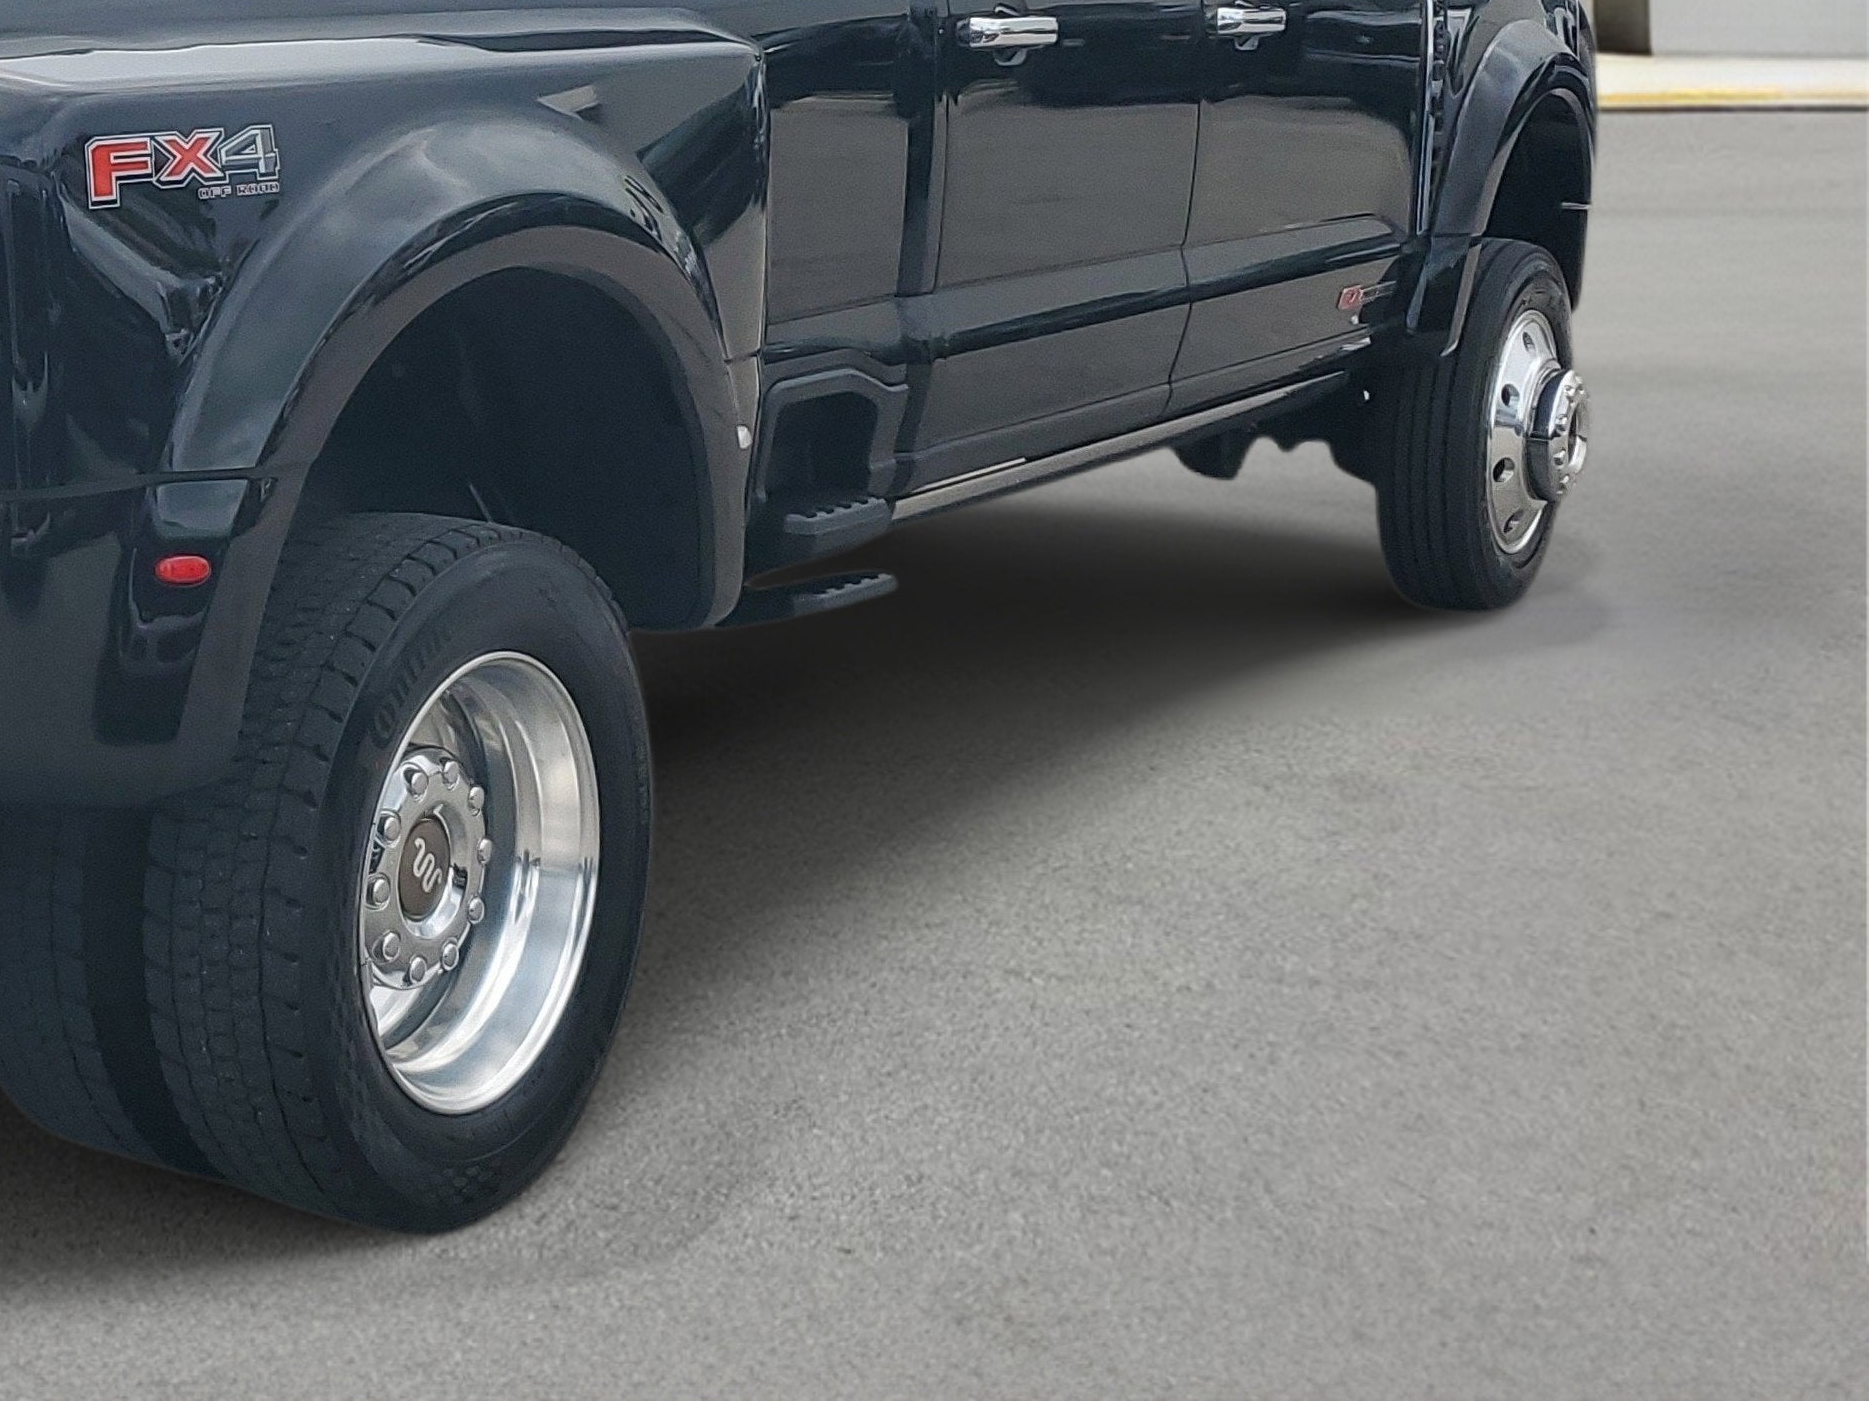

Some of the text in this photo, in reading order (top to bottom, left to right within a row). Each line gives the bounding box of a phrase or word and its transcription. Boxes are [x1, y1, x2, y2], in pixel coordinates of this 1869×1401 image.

[85, 124, 281, 209] FX4
[198, 181, 280, 200] OFF ROAD
